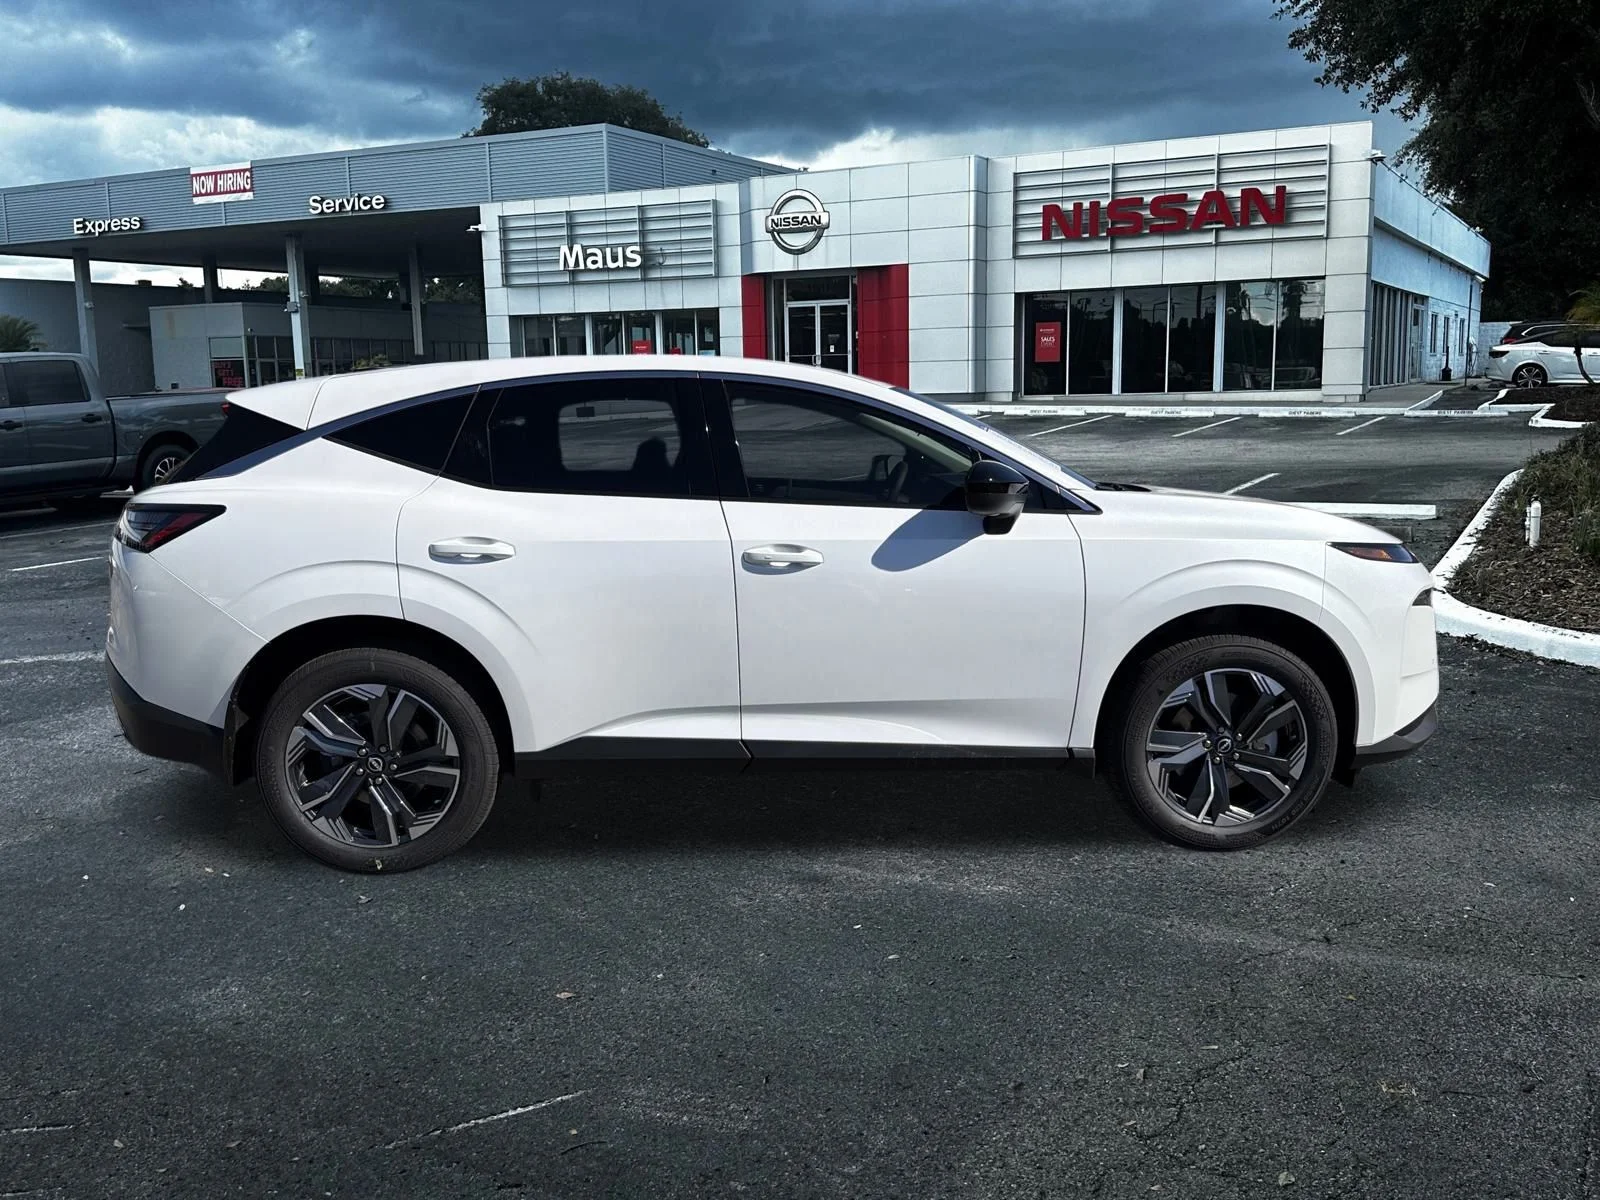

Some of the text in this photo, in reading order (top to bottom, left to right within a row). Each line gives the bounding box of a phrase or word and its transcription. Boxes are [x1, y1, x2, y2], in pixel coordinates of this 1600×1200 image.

[193, 171, 251, 195] NOW HIRING
[309, 193, 385, 214] Service
[1041, 185, 1287, 241] NISSAN
[73, 216, 141, 237] Express
[770, 214, 822, 229] NISSAN
[559, 243, 642, 271] Maus
